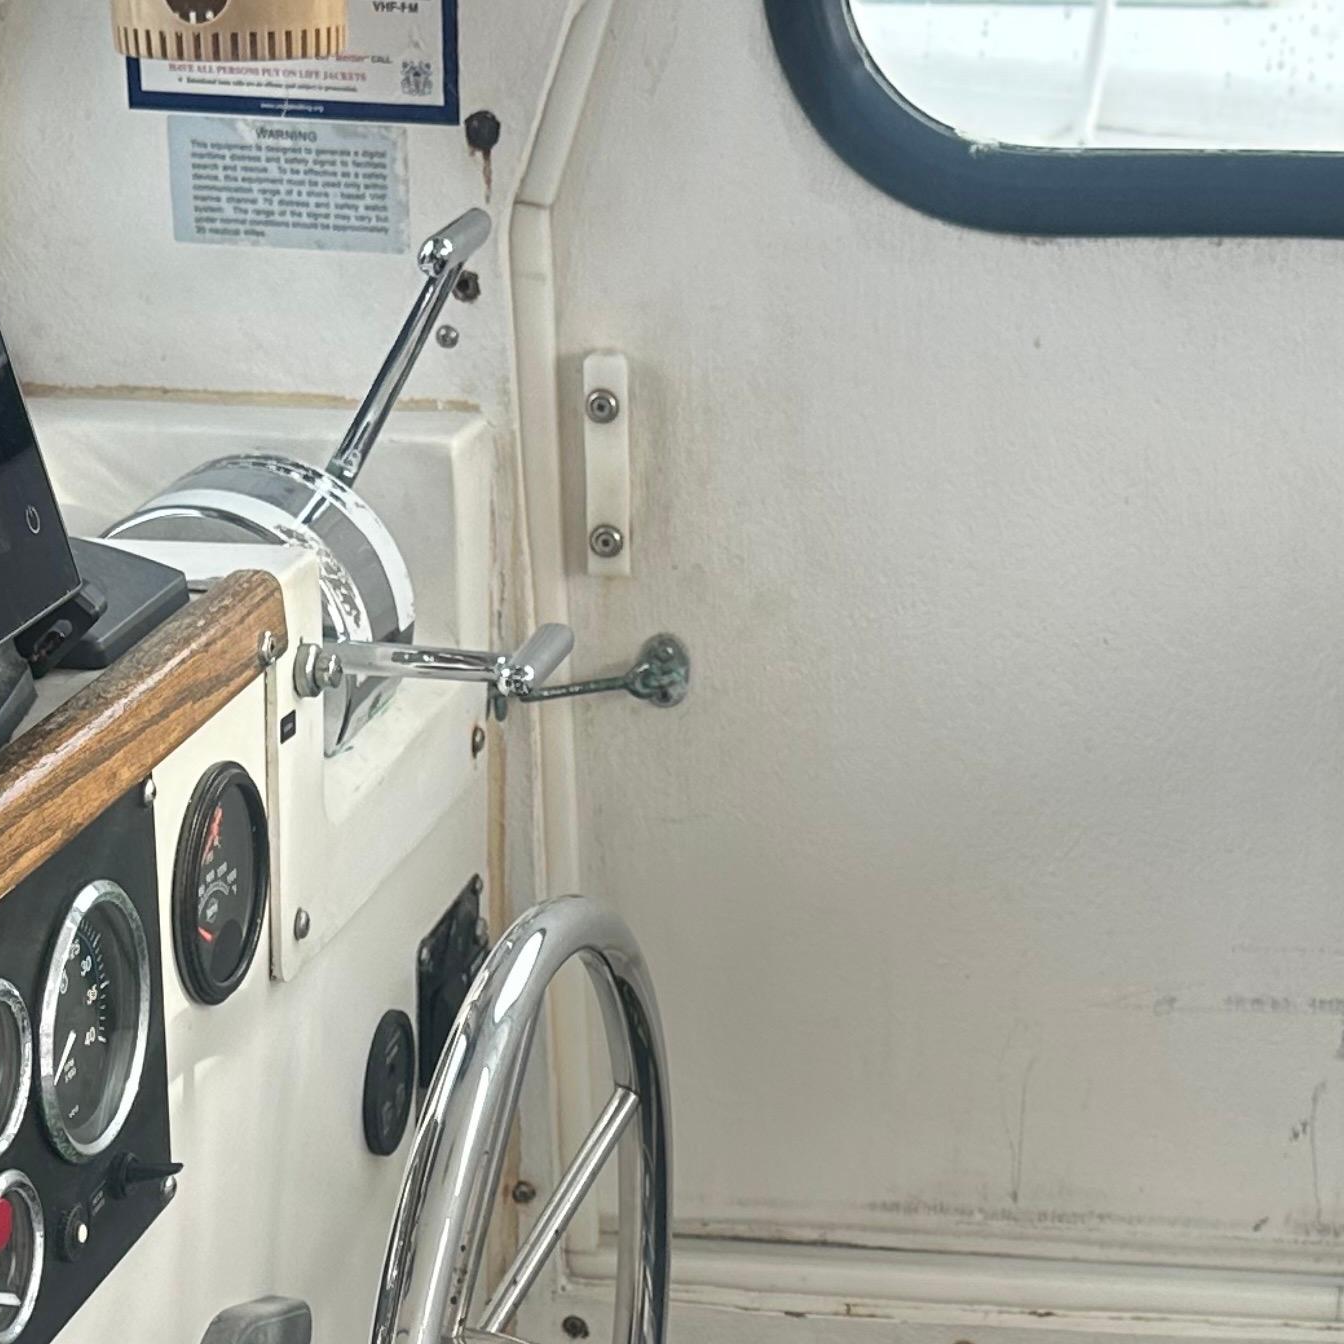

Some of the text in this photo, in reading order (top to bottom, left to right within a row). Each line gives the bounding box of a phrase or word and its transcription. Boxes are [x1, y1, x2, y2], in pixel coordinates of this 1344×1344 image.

[372, 0, 419, 14] VHF-FM
[256, 127, 318, 143] WARNING
[79, 954, 92, 978] 30
[86, 982, 98, 1007] 35
[84, 1025, 96, 1046] 40
